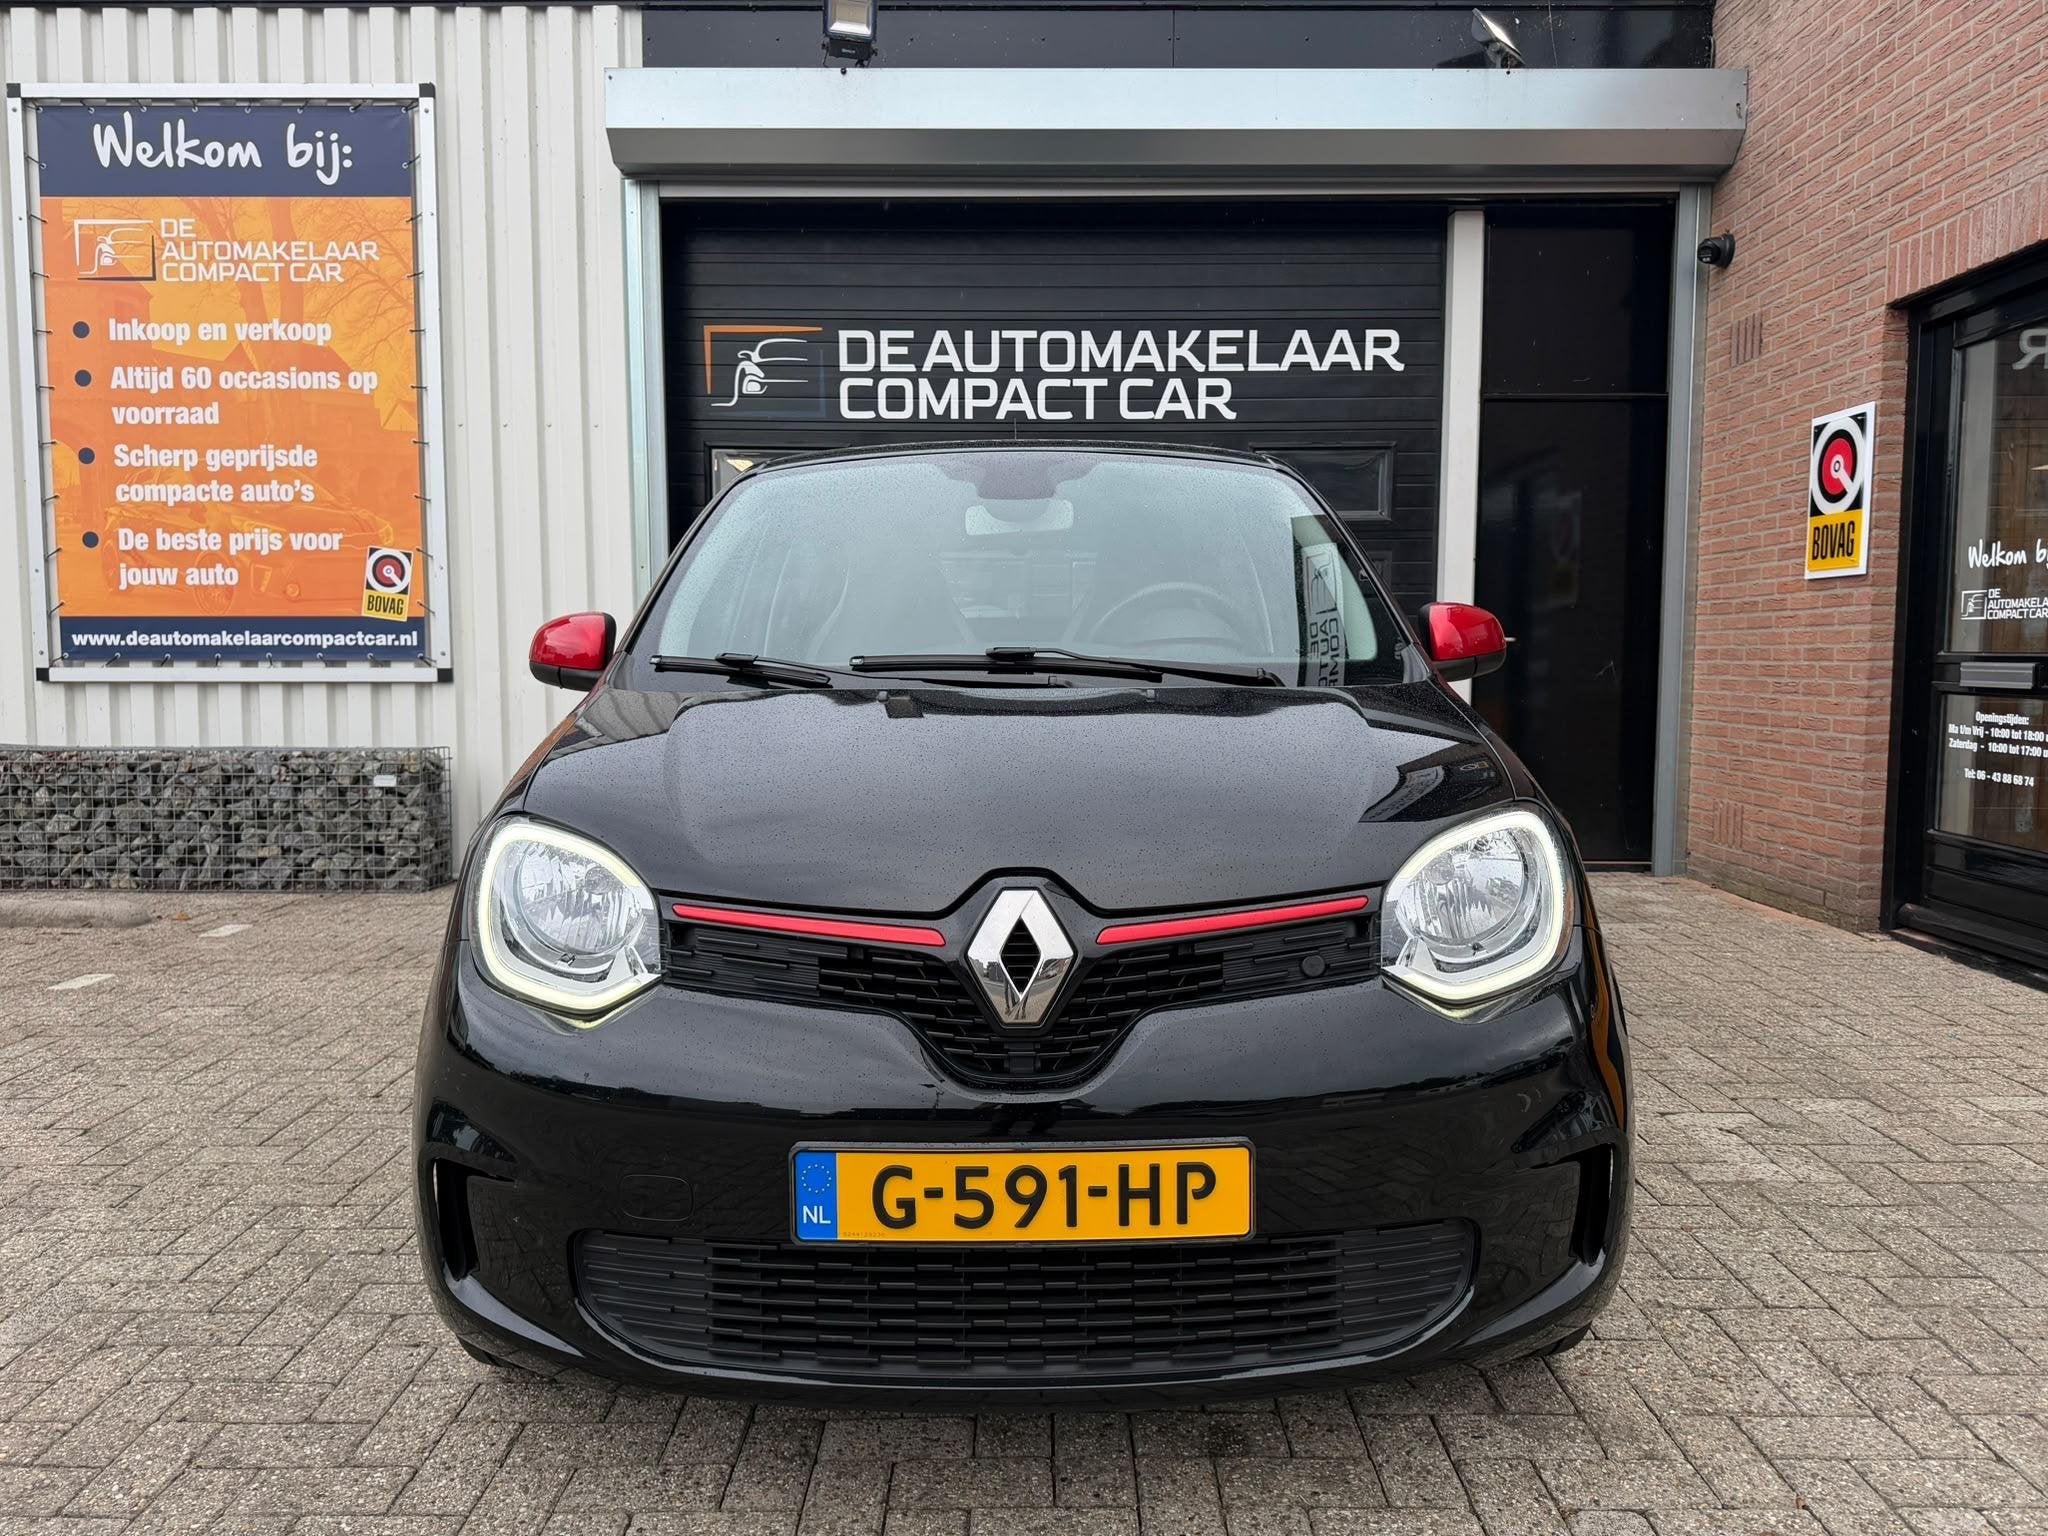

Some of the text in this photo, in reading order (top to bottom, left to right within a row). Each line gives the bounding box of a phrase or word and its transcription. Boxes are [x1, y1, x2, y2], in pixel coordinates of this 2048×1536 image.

[93, 112, 353, 185] Welkom bij:
[161, 218, 196, 238] DE
[162, 241, 379, 261] AUTOMAKELAAR
[162, 263, 344, 282] COMPACT CAR
[109, 318, 332, 344] Inkoop en verkoop
[839, 329, 1405, 372] DE AUTOMAKELAAR
[111, 366, 377, 394] Altijd 60 occasions op
[839, 377, 1237, 421] COMPACT CAR
[112, 402, 219, 425] voorraad
[114, 444, 318, 472] Scherp geprijsde
[115, 482, 234, 506] compacte
[118, 528, 342, 555] De beste prijs voor
[1811, 520, 1855, 560] BOVAG
[1968, 538, 2027, 569] Welkom
[119, 564, 239, 590] jouw auto
[1988, 588, 2001, 598] DE
[367, 594, 404, 616] BOVAG
[1987, 607, 2048, 620] COMPACT CAR
[72, 630, 418, 647] www.deautomakelaarcompactcar.nl
[1975, 711, 2029, 726] Openingstijden:
[1972, 725, 1984, 738] Vrij
[1990, 727, 2010, 739] 10:00
[2011, 729, 2022, 740] tot
[2023, 730, 2045, 743] 18:00
[1948, 738, 1978, 752] Zaterdag
[1988, 741, 2008, 754] 10:00
[2009, 743, 2020, 755] tot
[2021, 745, 2042, 757] 17:00
[1964, 768, 1976, 779] Tel:
[1976, 770, 1986, 781] 06
[1992, 772, 2002, 783] 43
[2002, 773, 2013, 784] 88
[2013, 774, 2023, 786] 68
[2024, 776, 2035, 787] 74
[872, 1161, 1217, 1230] G-591-HP
[802, 1205, 831, 1224] NL
